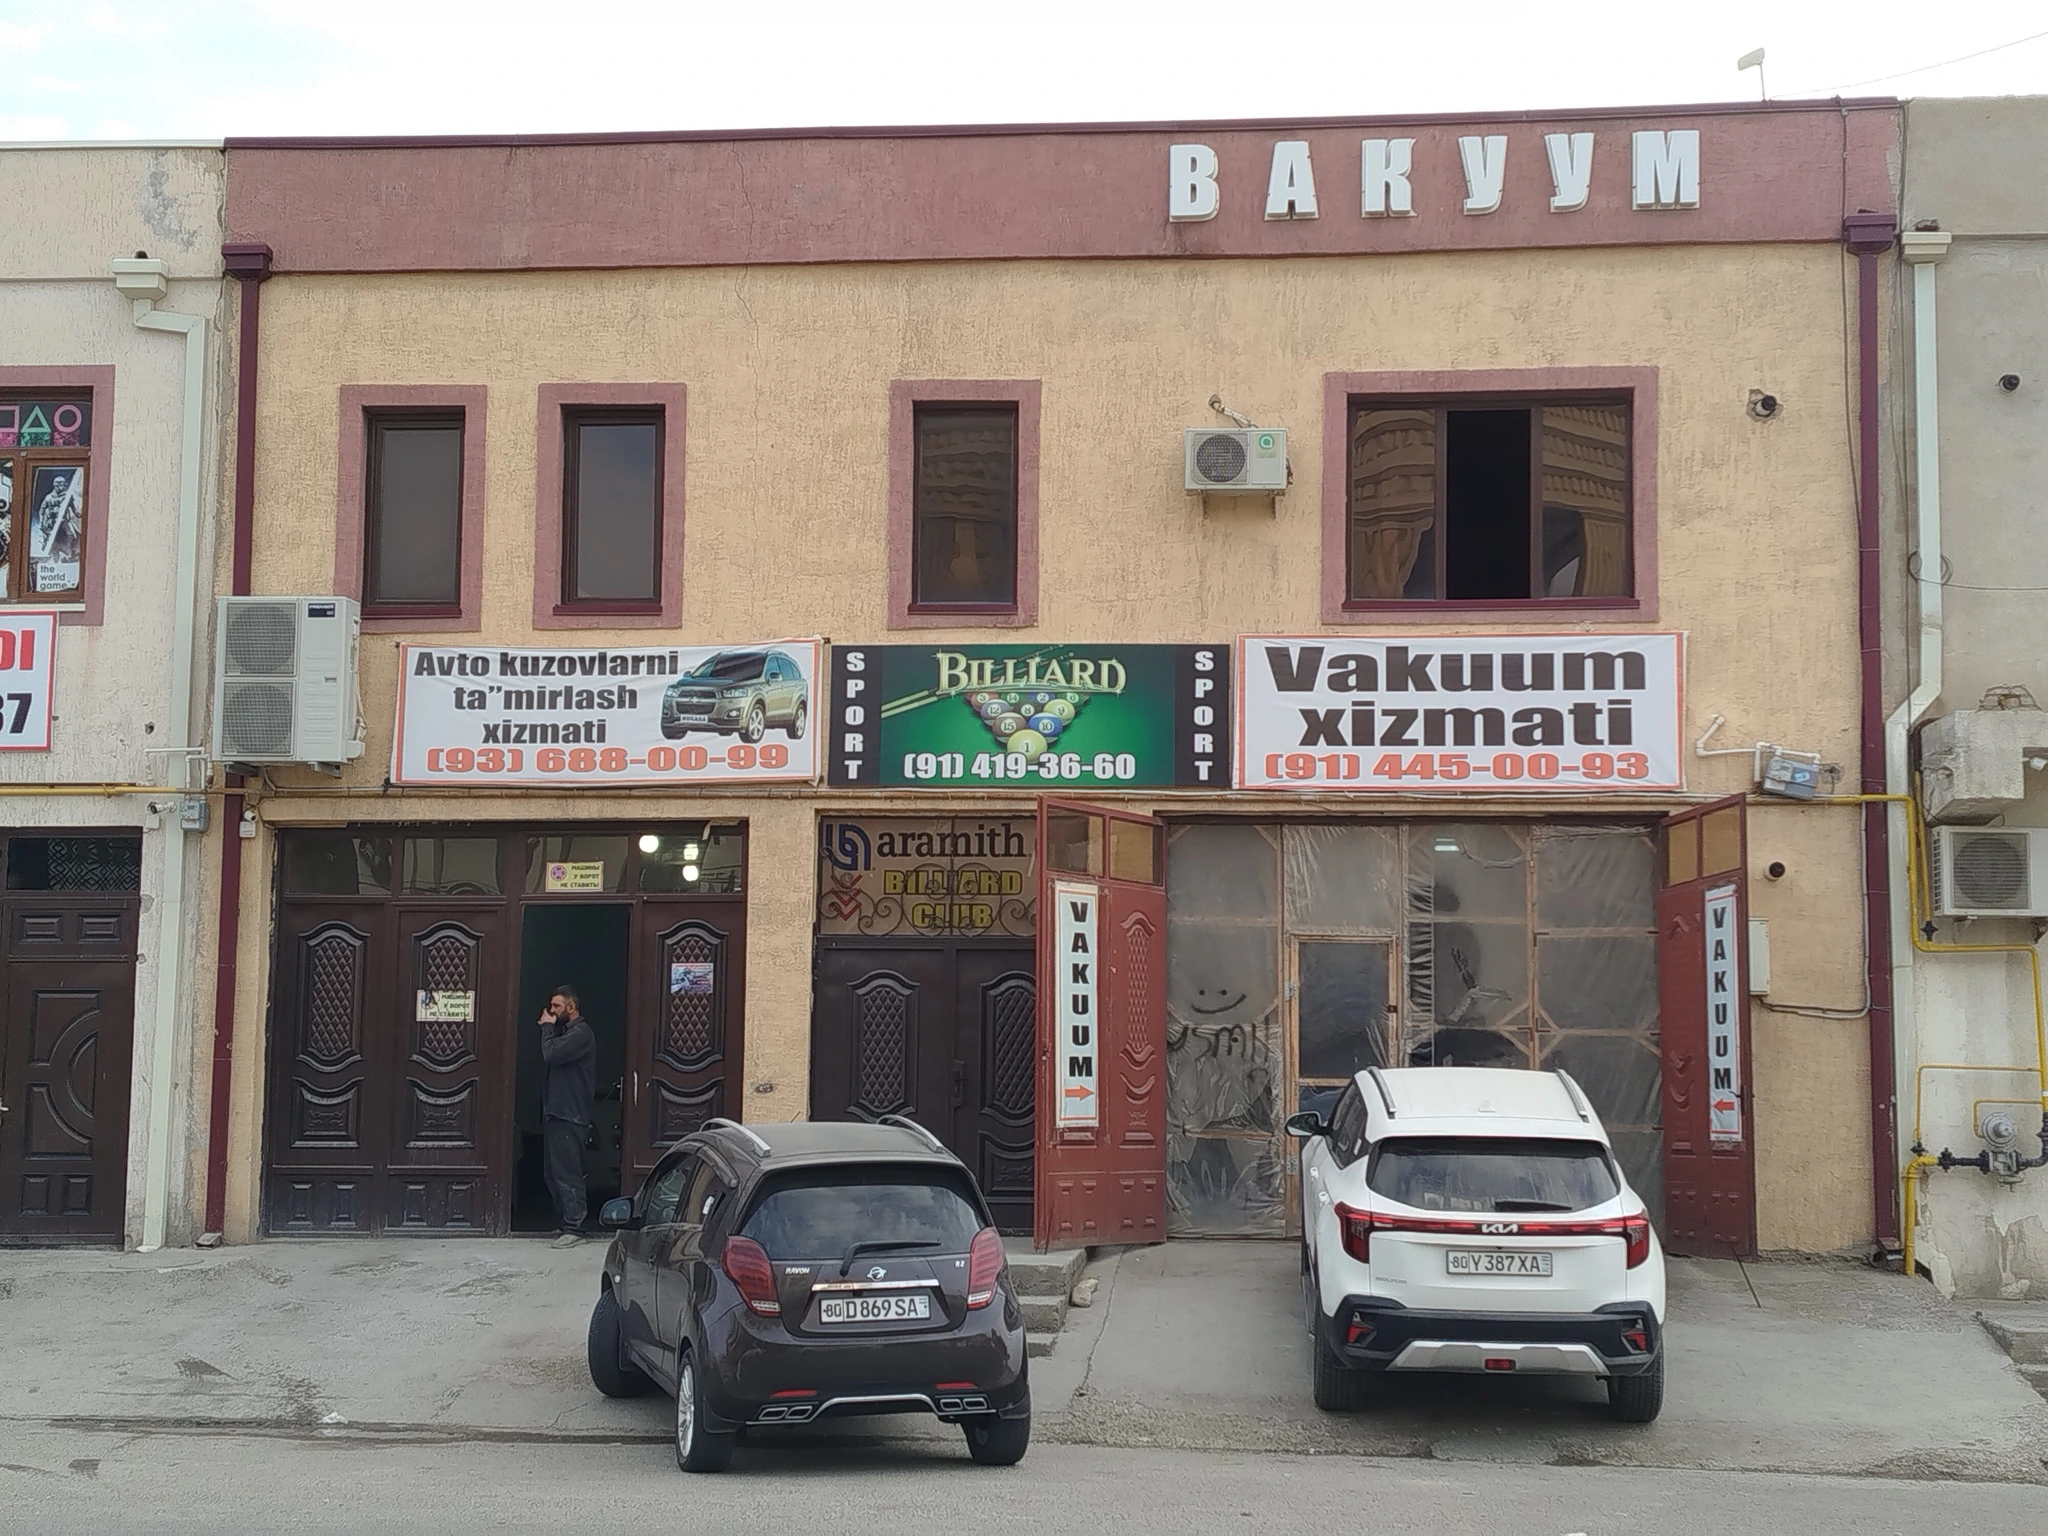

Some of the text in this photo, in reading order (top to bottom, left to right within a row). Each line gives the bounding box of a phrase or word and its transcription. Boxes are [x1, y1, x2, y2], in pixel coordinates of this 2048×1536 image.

[1169, 130, 1700, 222] ВАКУУМ
[40, 565, 55, 573] the
[40, 573, 66, 582] world
[414, 650, 679, 677] Avto kuzovlarni
[938, 651, 1126, 695] BILLIARD
[1264, 645, 1647, 693] Vakuum
[0, 692, 33, 735] 7
[844, 651, 866, 780] SPORT
[989, 706, 1000, 715] 12
[1193, 650, 1215, 781] SPORT
[1298, 699, 1633, 747] xizmati
[482, 719, 607, 744] xizmati
[1003, 721, 1015, 731] 15
[1041, 721, 1053, 731] 10
[427, 744, 789, 773] (93) 688-00-99
[903, 752, 1136, 780] (91) 419-36-60
[1265, 752, 1650, 780] (91) 445-00-93
[877, 823, 1028, 858] aramith
[911, 902, 994, 929] CLUB
[1068, 901, 1093, 1077] VAKUUM
[1712, 905, 1732, 1091] VAKUUM
[785, 1267, 811, 1275] RAVON
